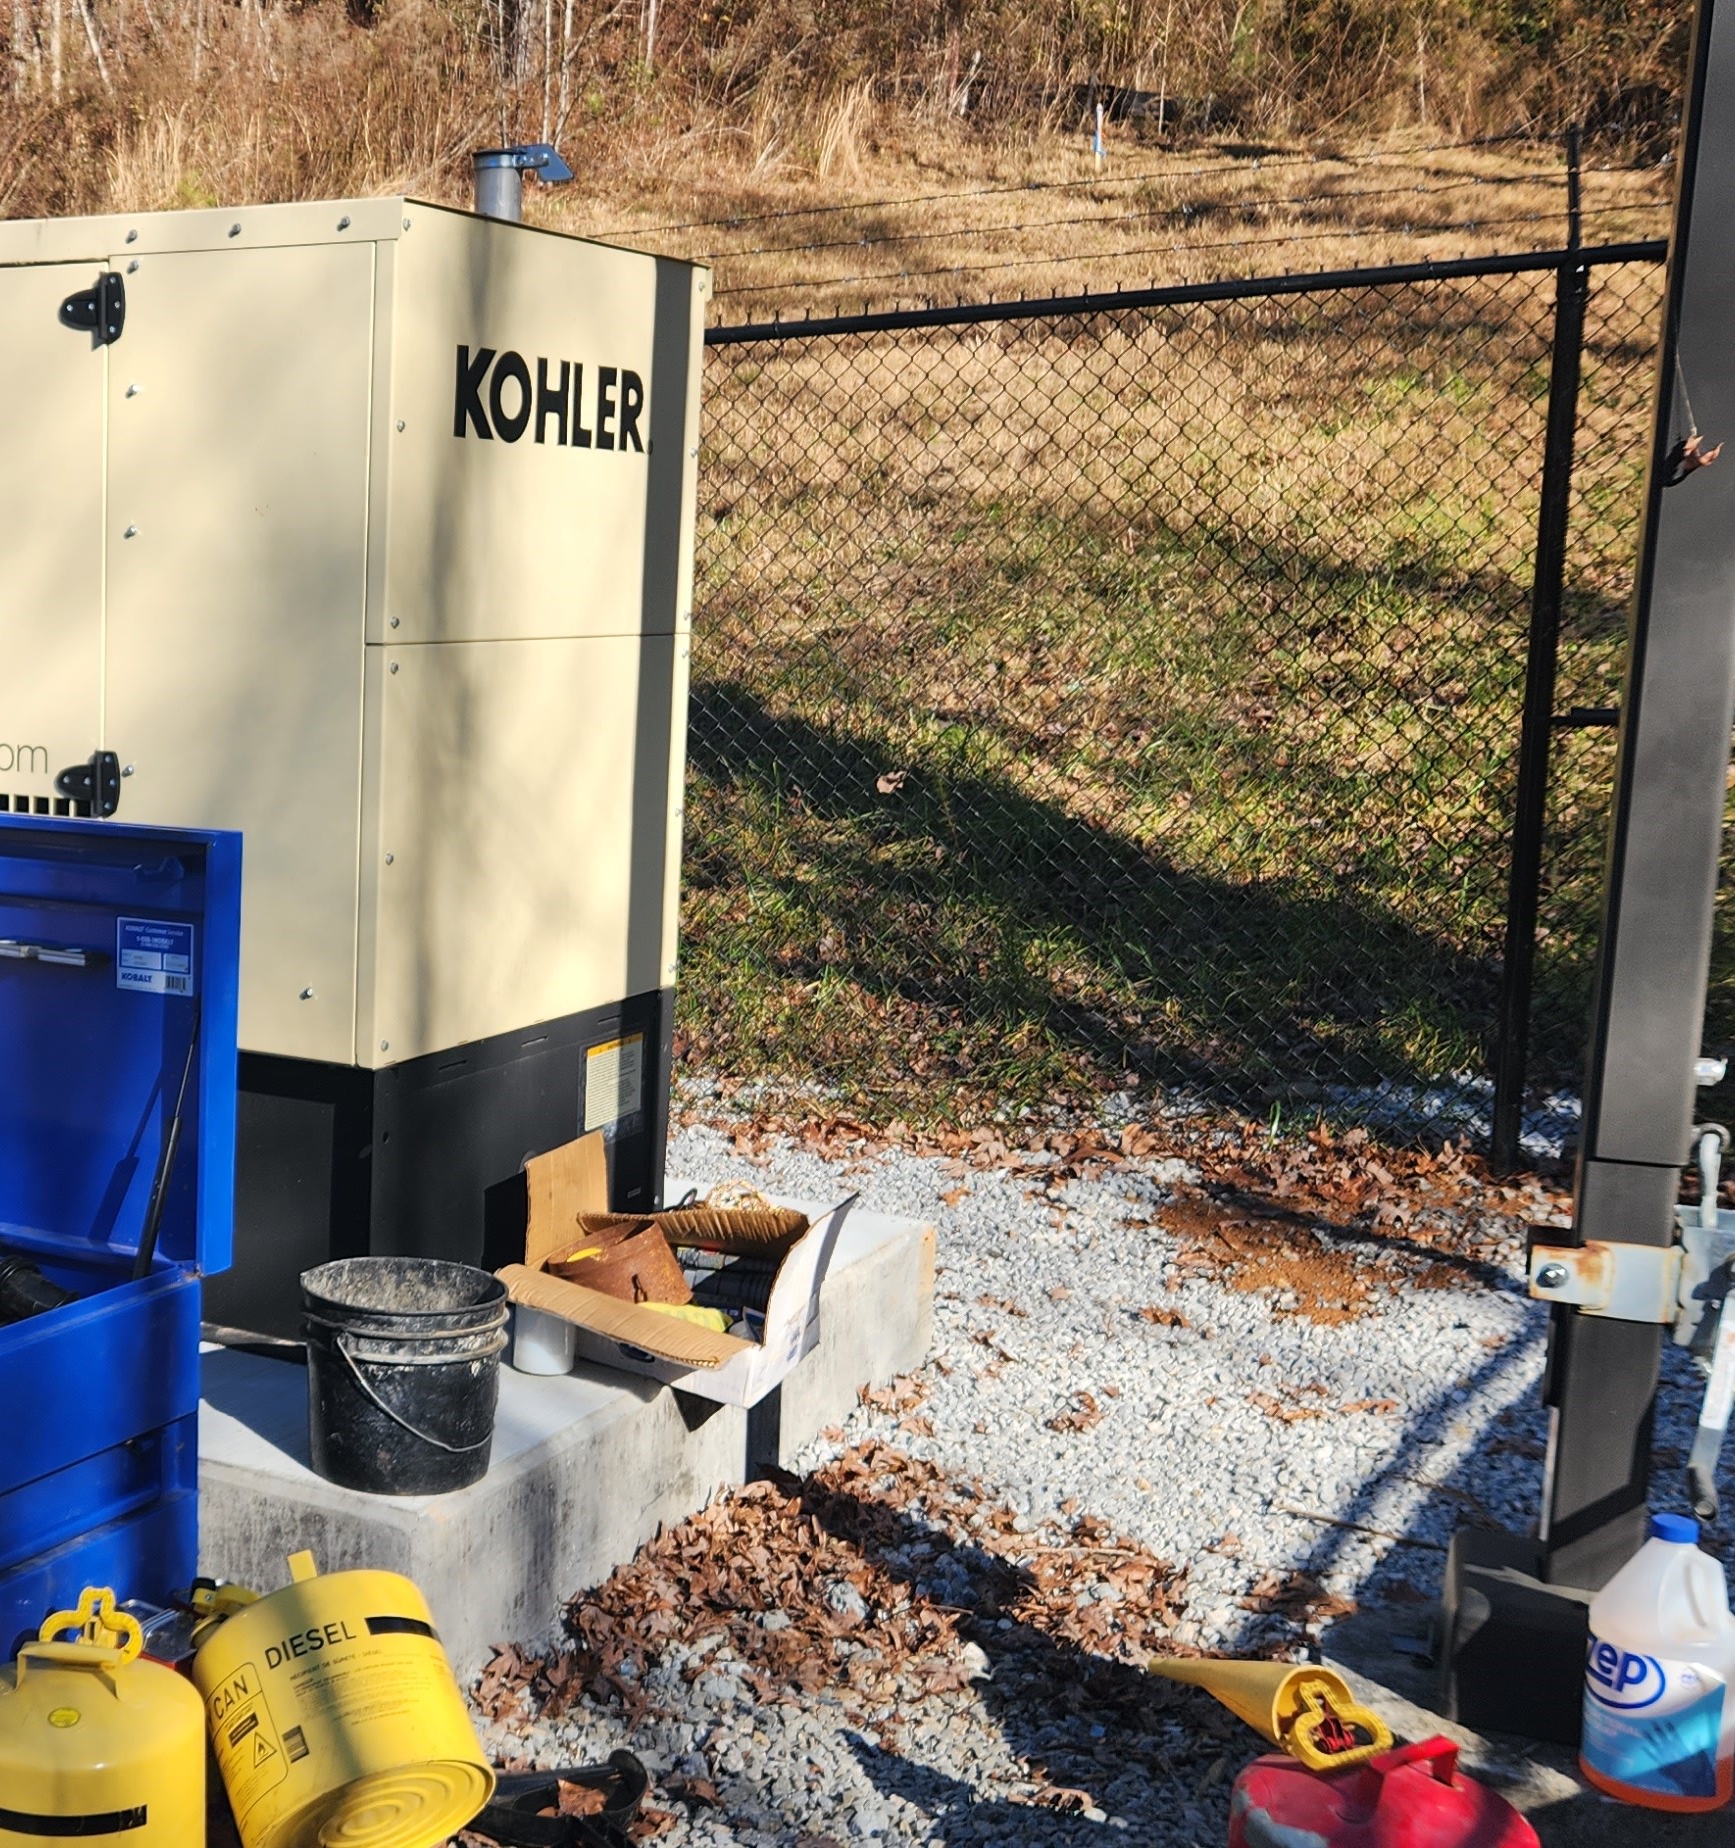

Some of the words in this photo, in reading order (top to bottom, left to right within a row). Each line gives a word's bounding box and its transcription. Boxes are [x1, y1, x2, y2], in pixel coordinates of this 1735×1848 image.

[453, 344, 646, 454] KOHLER
[264, 1620, 357, 1670] DIESEL
[213, 1674, 249, 1720] CAN
